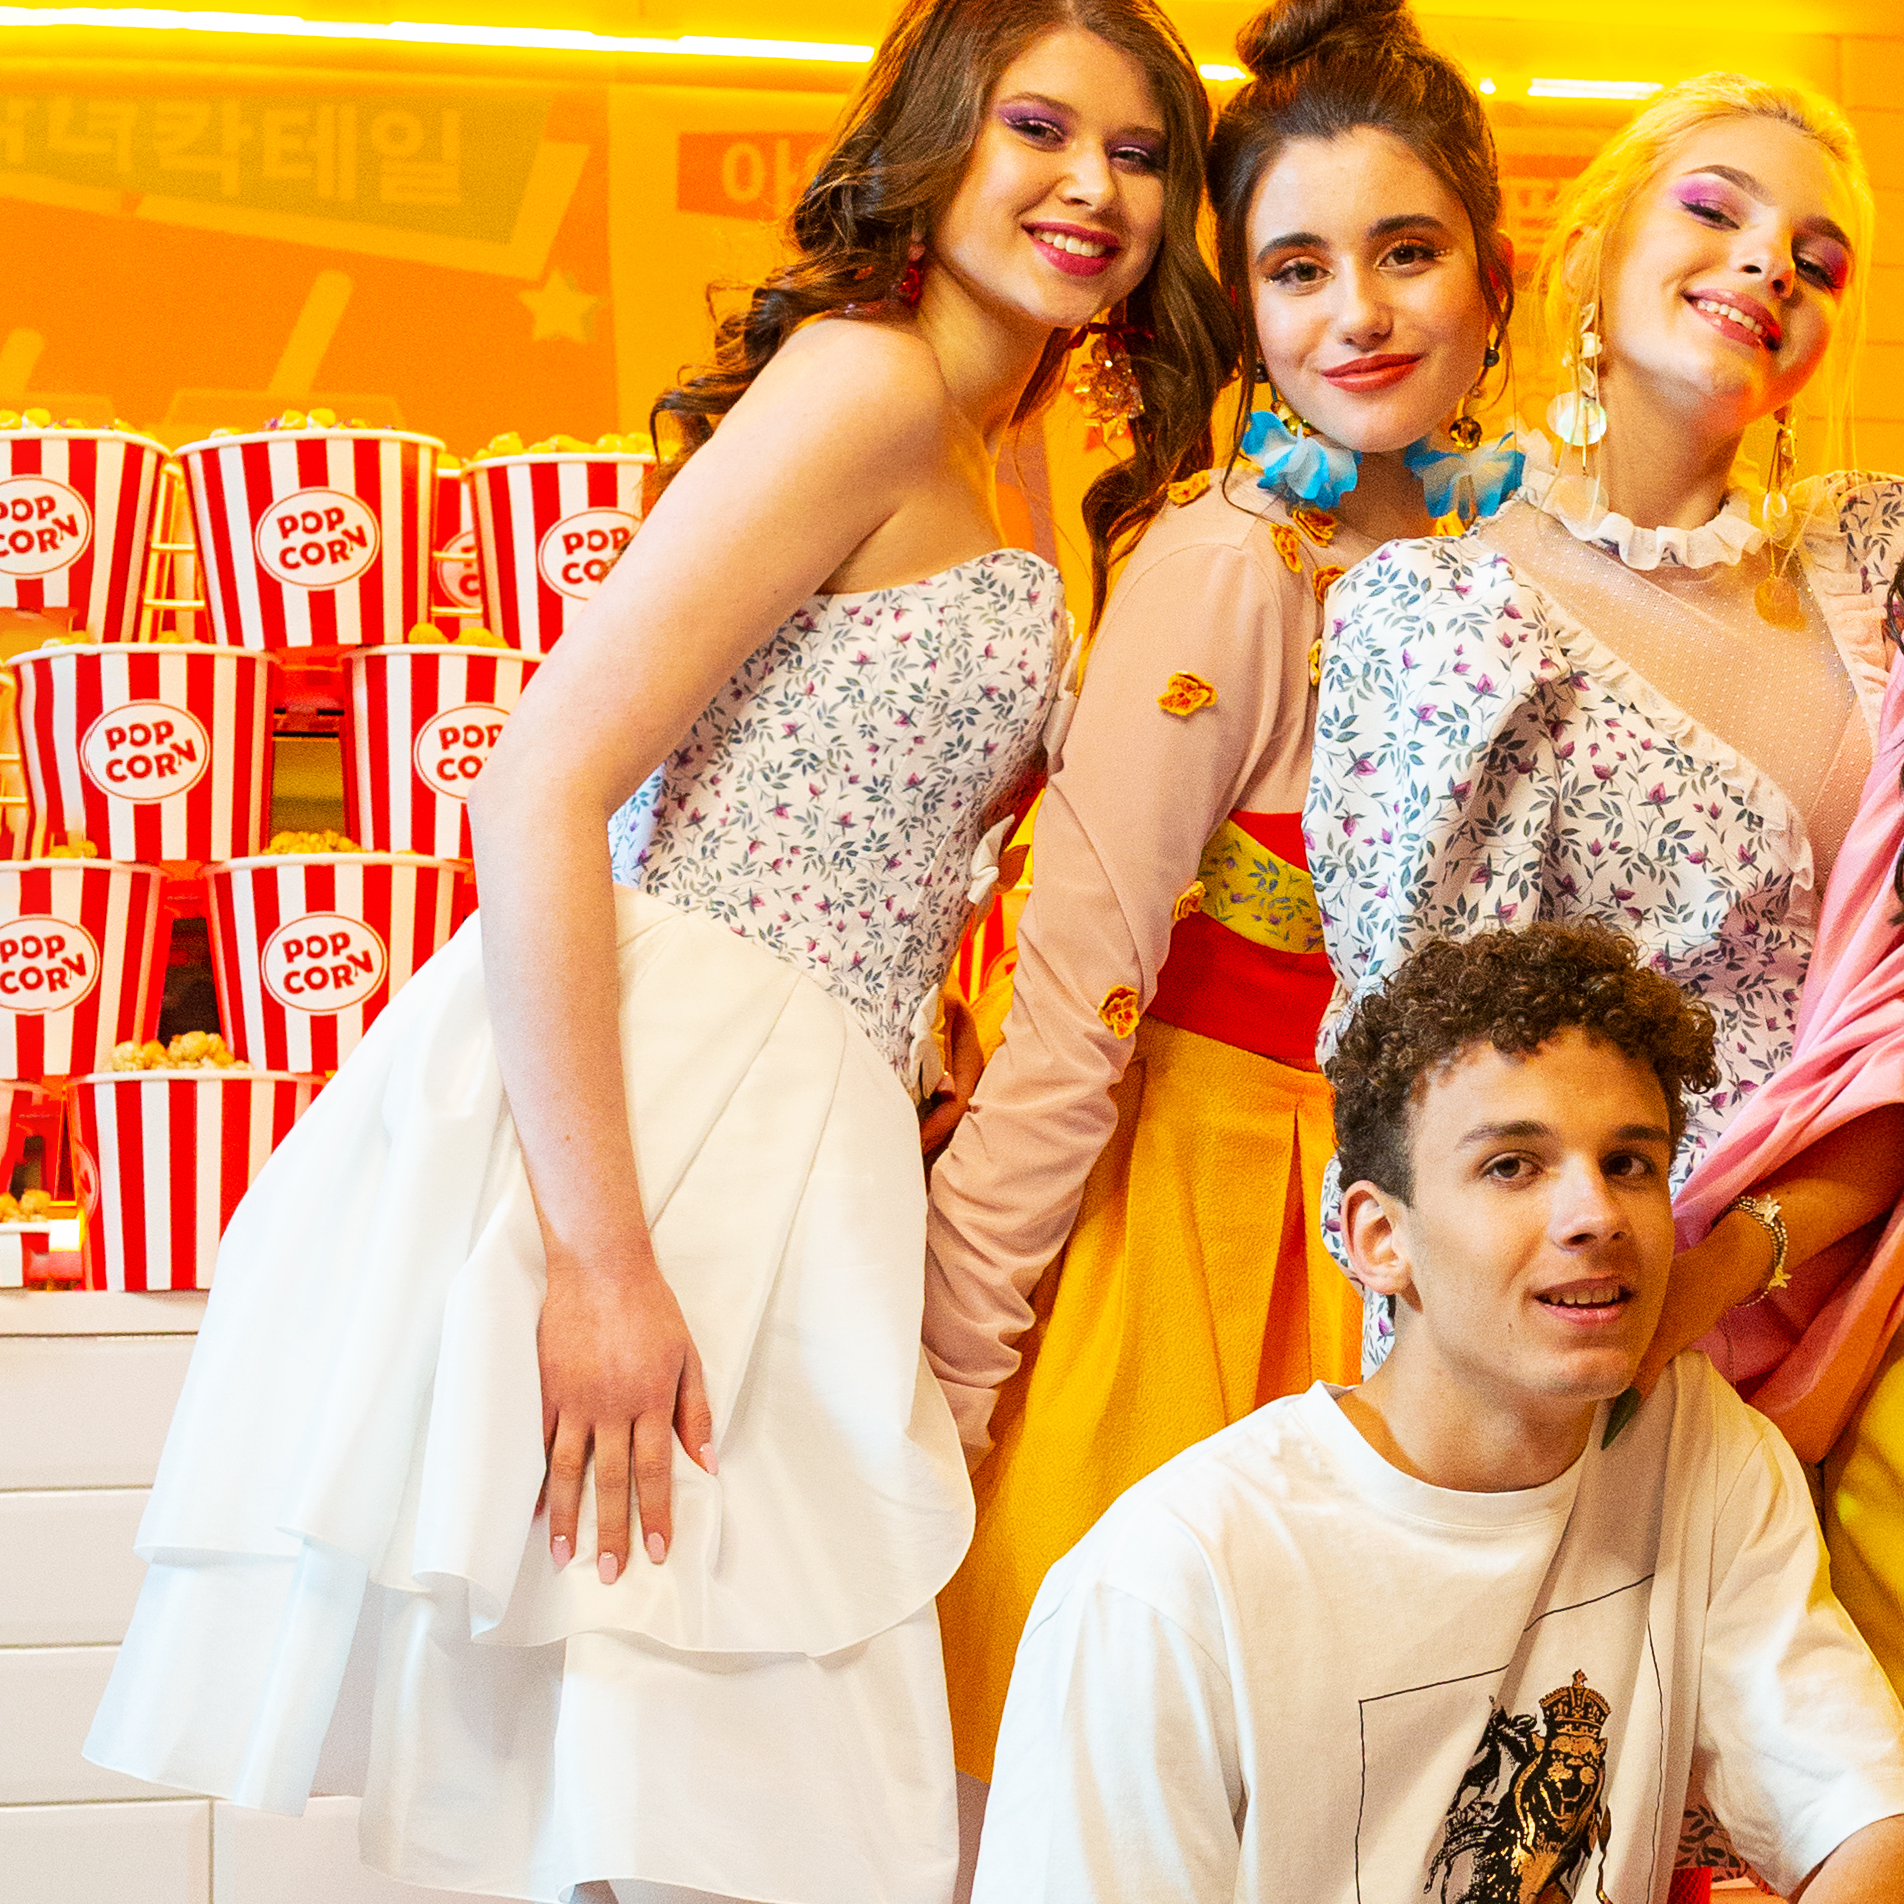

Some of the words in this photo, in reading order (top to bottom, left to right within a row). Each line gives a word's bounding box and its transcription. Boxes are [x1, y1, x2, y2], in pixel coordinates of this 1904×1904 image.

[277, 506, 345, 540] POP
[279, 524, 368, 570] CORN
[562, 526, 631, 556] POP
[105, 720, 174, 752] POP
[105, 738, 197, 783] CORN
[0, 934, 66, 964] POP
[282, 931, 351, 964] POP
[0, 952, 87, 994] CORN
[283, 949, 374, 995] CORN
